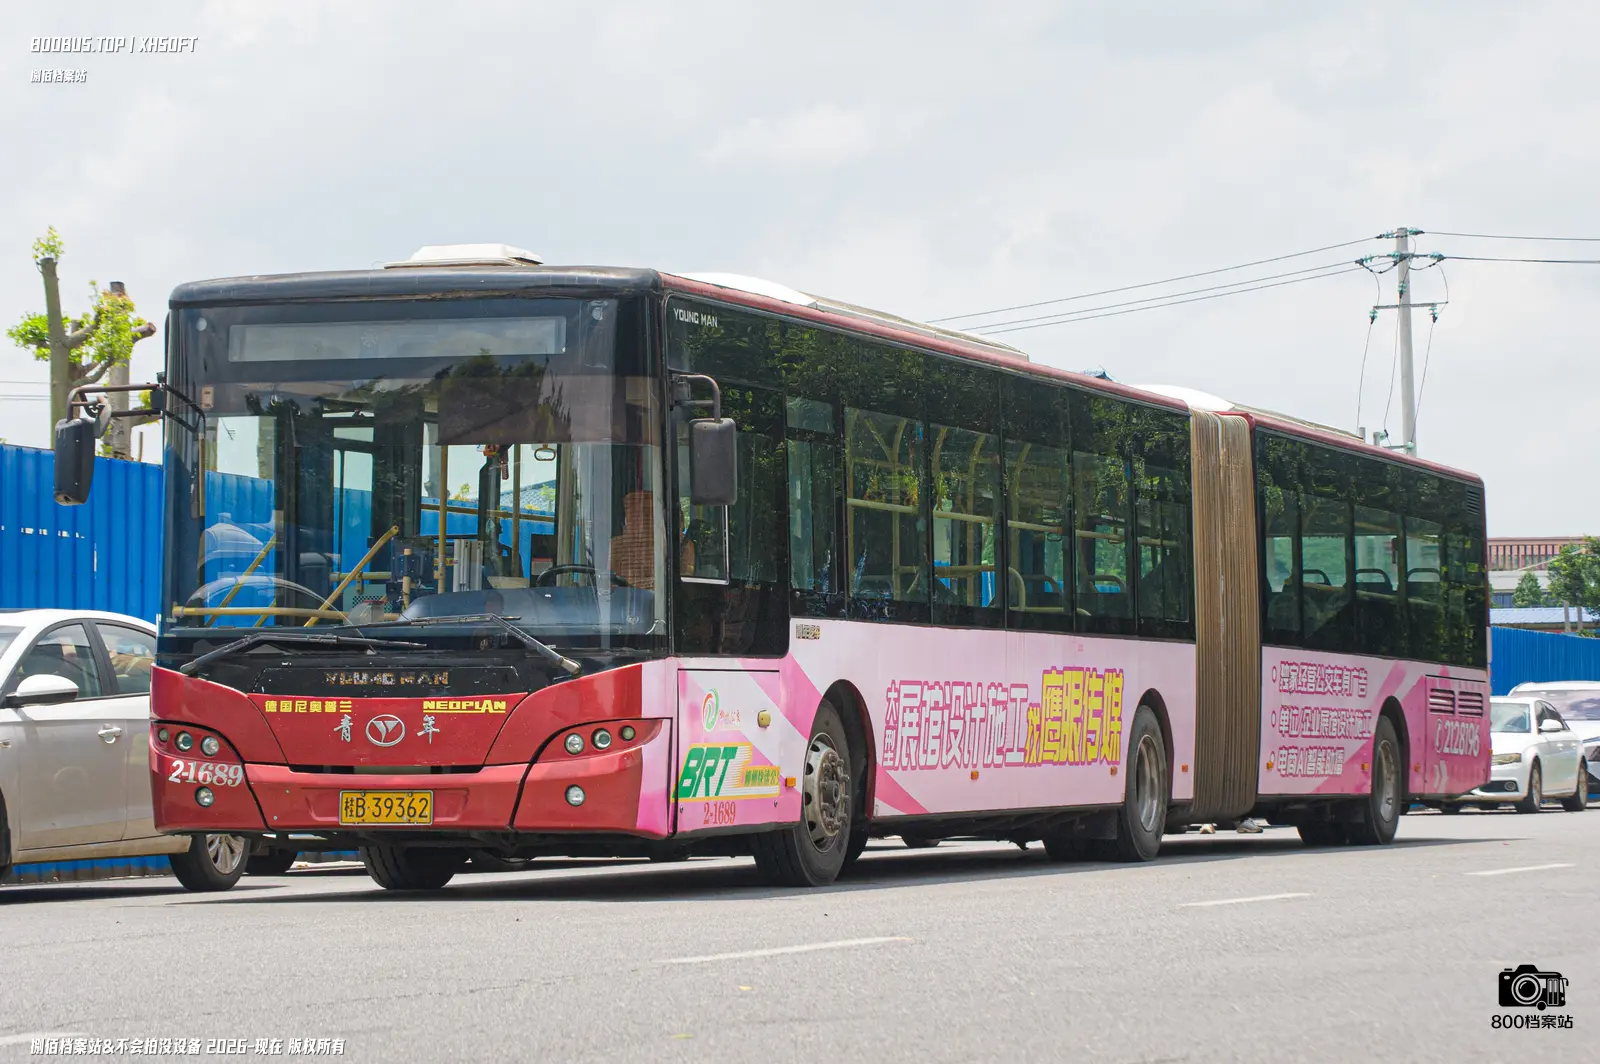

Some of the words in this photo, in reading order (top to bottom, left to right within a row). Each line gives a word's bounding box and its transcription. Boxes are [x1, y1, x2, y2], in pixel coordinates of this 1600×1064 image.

[673, 307, 699, 325] YOUNG
[700, 313, 718, 328] MAN
[265, 700, 352, 713] 德国尼奥普兰
[422, 700, 507, 713] NEOPLAN
[333, 713, 354, 743] 青
[416, 714, 441, 744] 年
[1443, 719, 1480, 757] 2128196
[168, 759, 244, 787] 2-1689
[671, 746, 739, 799] BRT
[703, 803, 736, 825] 2-1689
